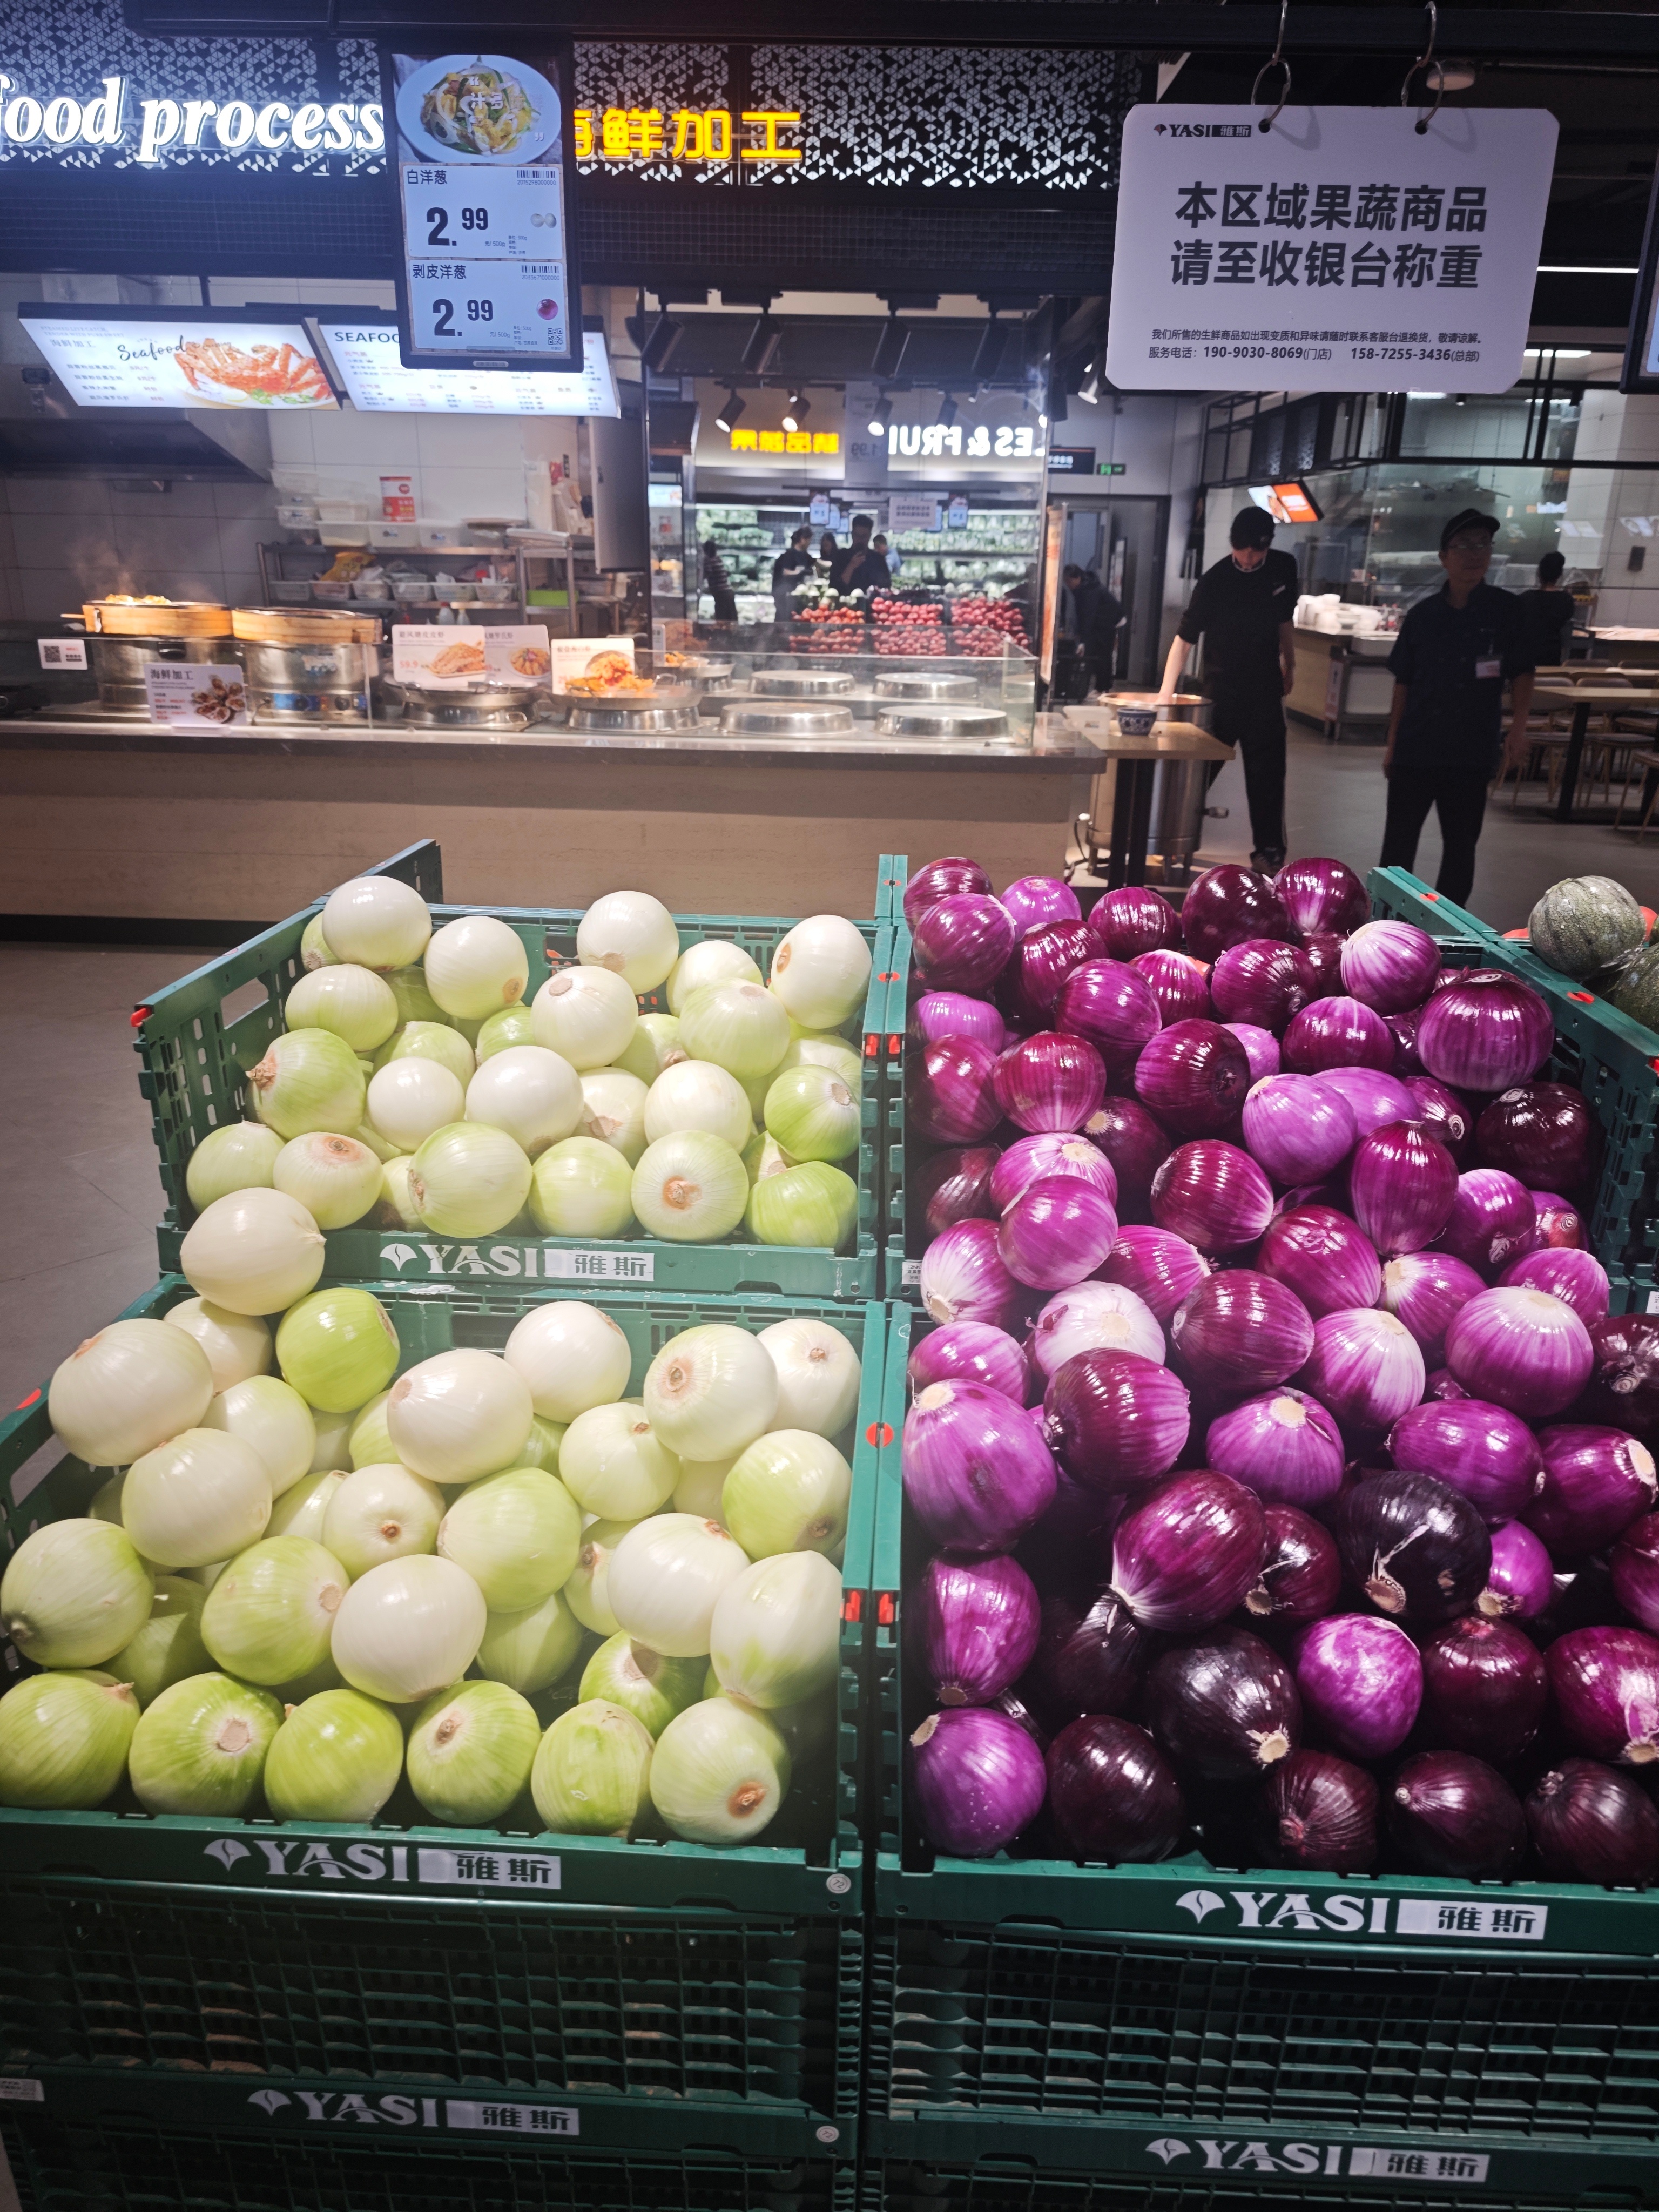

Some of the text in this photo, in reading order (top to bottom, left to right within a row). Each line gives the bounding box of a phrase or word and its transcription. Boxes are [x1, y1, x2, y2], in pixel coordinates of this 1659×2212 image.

[1169, 124, 1250, 137] YASI 雅斯
[407, 169, 447, 185] 白洋葱
[1175, 181, 1487, 232] 本区域果蔬商品
[412, 264, 467, 279] 剥皮洋葱
[1171, 239, 1482, 288] 请至收银台称重
[117, 335, 187, 362] Seafood
[418, 1244, 648, 1278] YASI 雅斯
[253, 1839, 552, 1884] YASI 雅斯
[1230, 1891, 1537, 1934] YASI 雅斯
[293, 2091, 571, 2131] YASI 雅斯
[1195, 2139, 1480, 2177] YASI 雅斯
